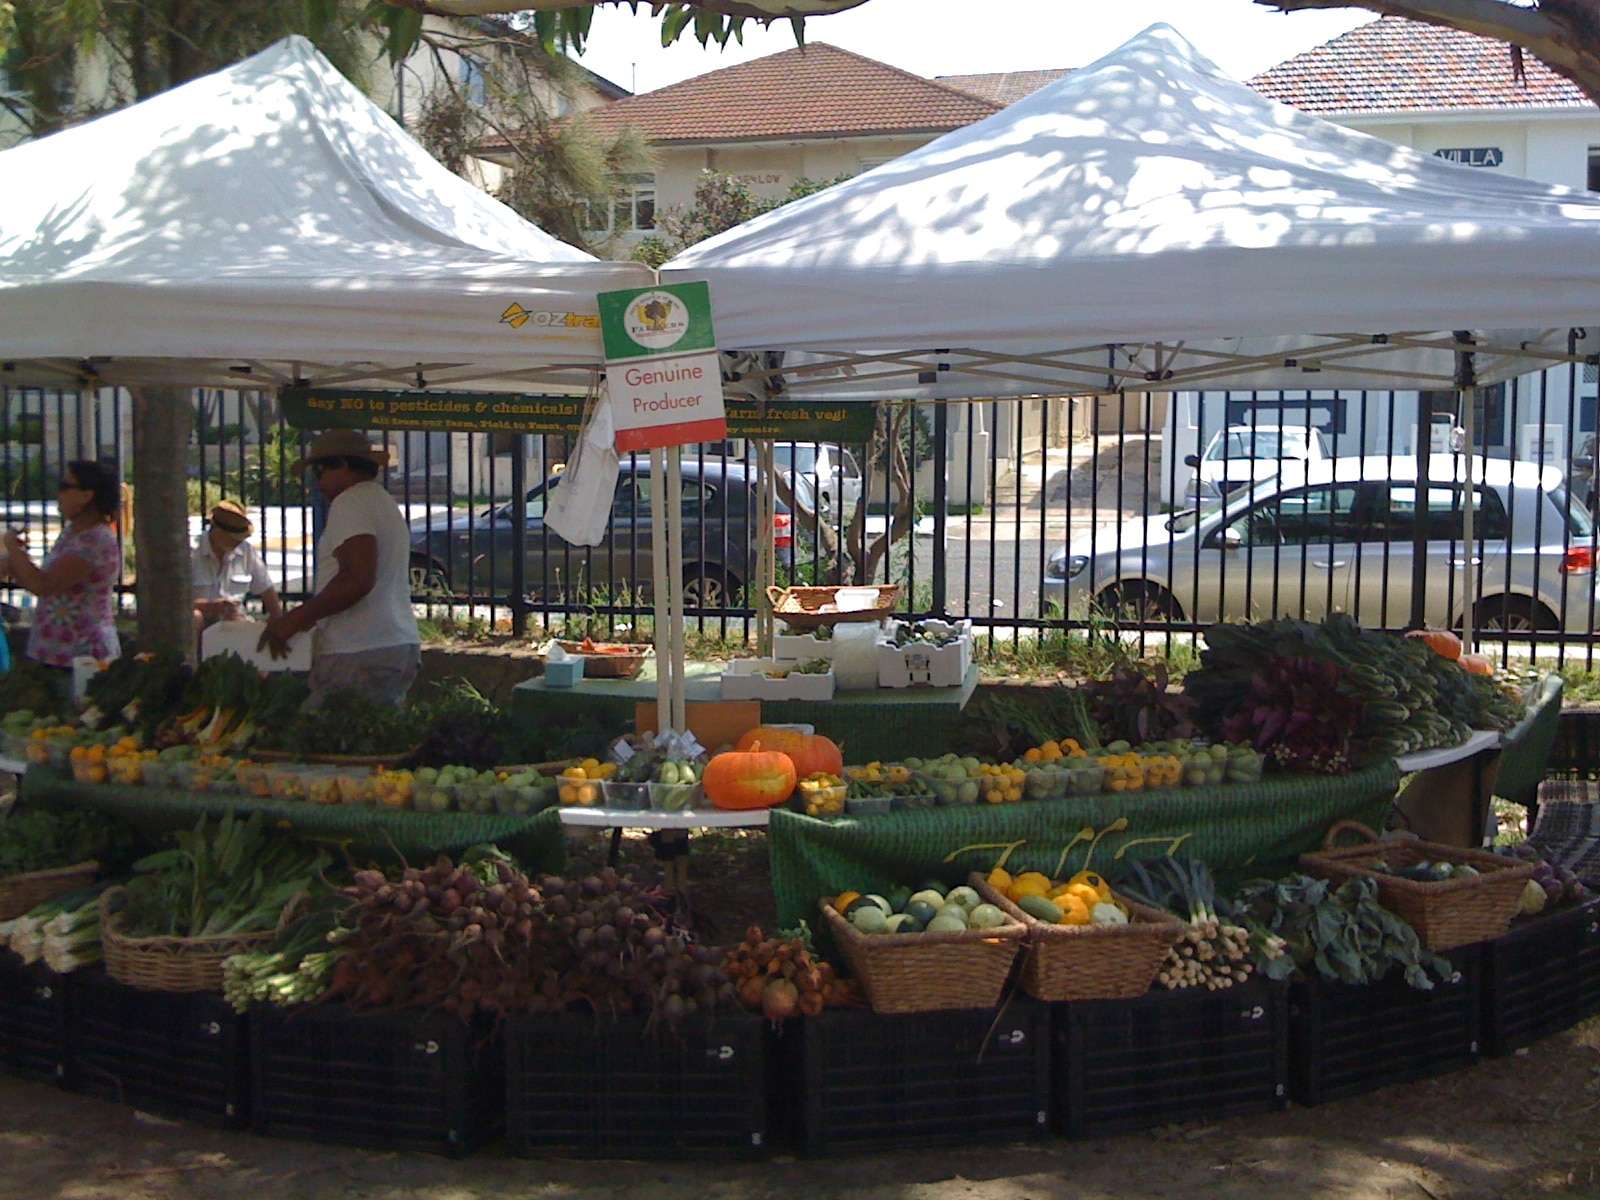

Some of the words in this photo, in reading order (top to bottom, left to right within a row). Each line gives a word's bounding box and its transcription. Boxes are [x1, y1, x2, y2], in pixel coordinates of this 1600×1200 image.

[1439, 148, 1498, 166] VILLA
[532, 311, 601, 329] OZtra
[625, 363, 703, 386] Genuine
[308, 398, 336, 410] Say
[340, 399, 365, 410] NO
[369, 400, 384, 410] to
[390, 401, 470, 413] pesticides
[474, 402, 488, 414] &
[492, 402, 578, 415] chemicals!
[633, 392, 702, 412] Producer
[766, 407, 810, 420] fresh
